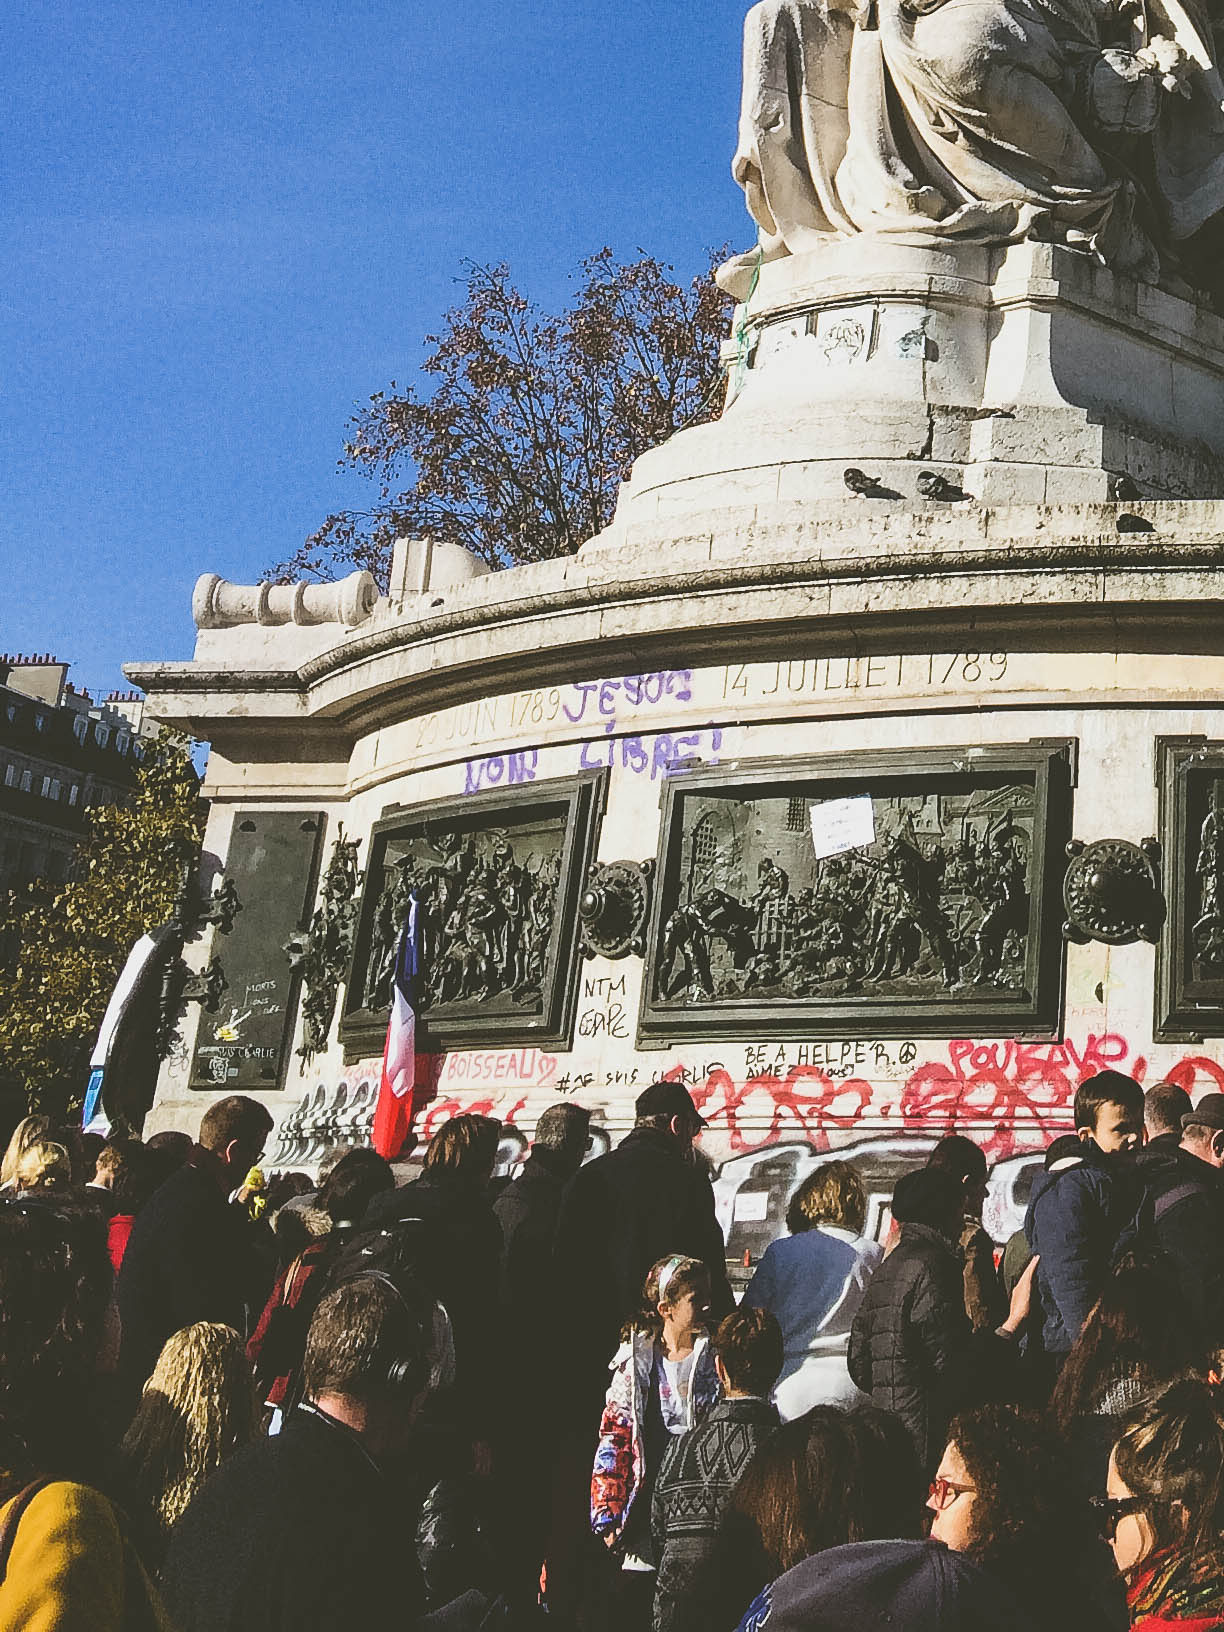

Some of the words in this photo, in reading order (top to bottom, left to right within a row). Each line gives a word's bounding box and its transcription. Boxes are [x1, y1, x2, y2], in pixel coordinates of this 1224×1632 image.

[722, 662, 749, 699] 14
[927, 652, 1009, 685] 1789
[446, 699, 498, 740] JUIN
[510, 688, 561, 728] 1789
[585, 974, 626, 1003] NTM
[745, 1044, 769, 1066] BE
[775, 1043, 787, 1063] A
